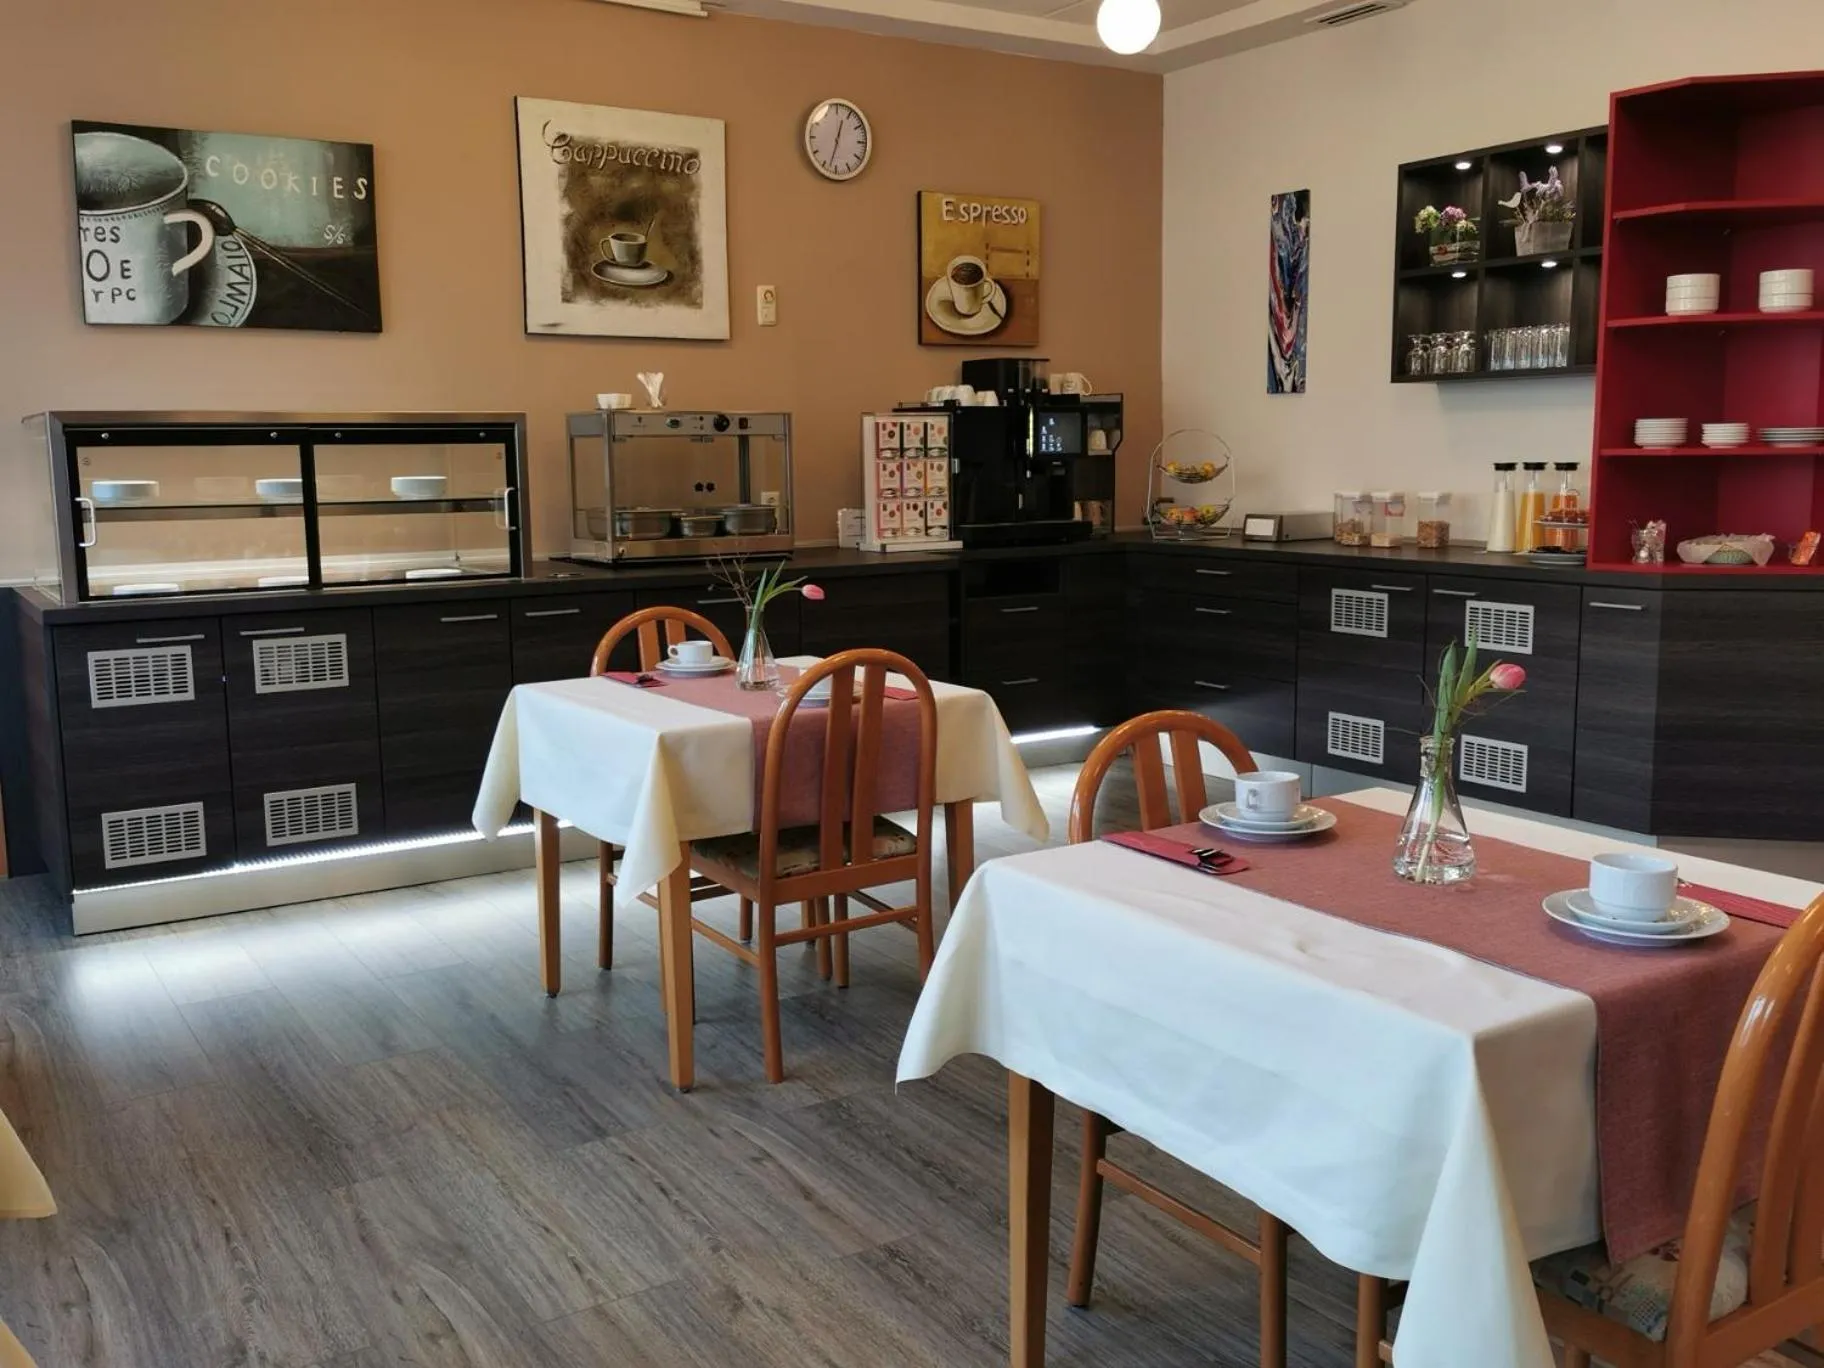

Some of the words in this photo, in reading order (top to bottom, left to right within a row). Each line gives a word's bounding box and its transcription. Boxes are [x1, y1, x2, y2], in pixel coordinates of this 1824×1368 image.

[542, 119, 702, 175] Cappuccino
[205, 156, 368, 199] COOKIES
[942, 197, 1028, 227] Espresso
